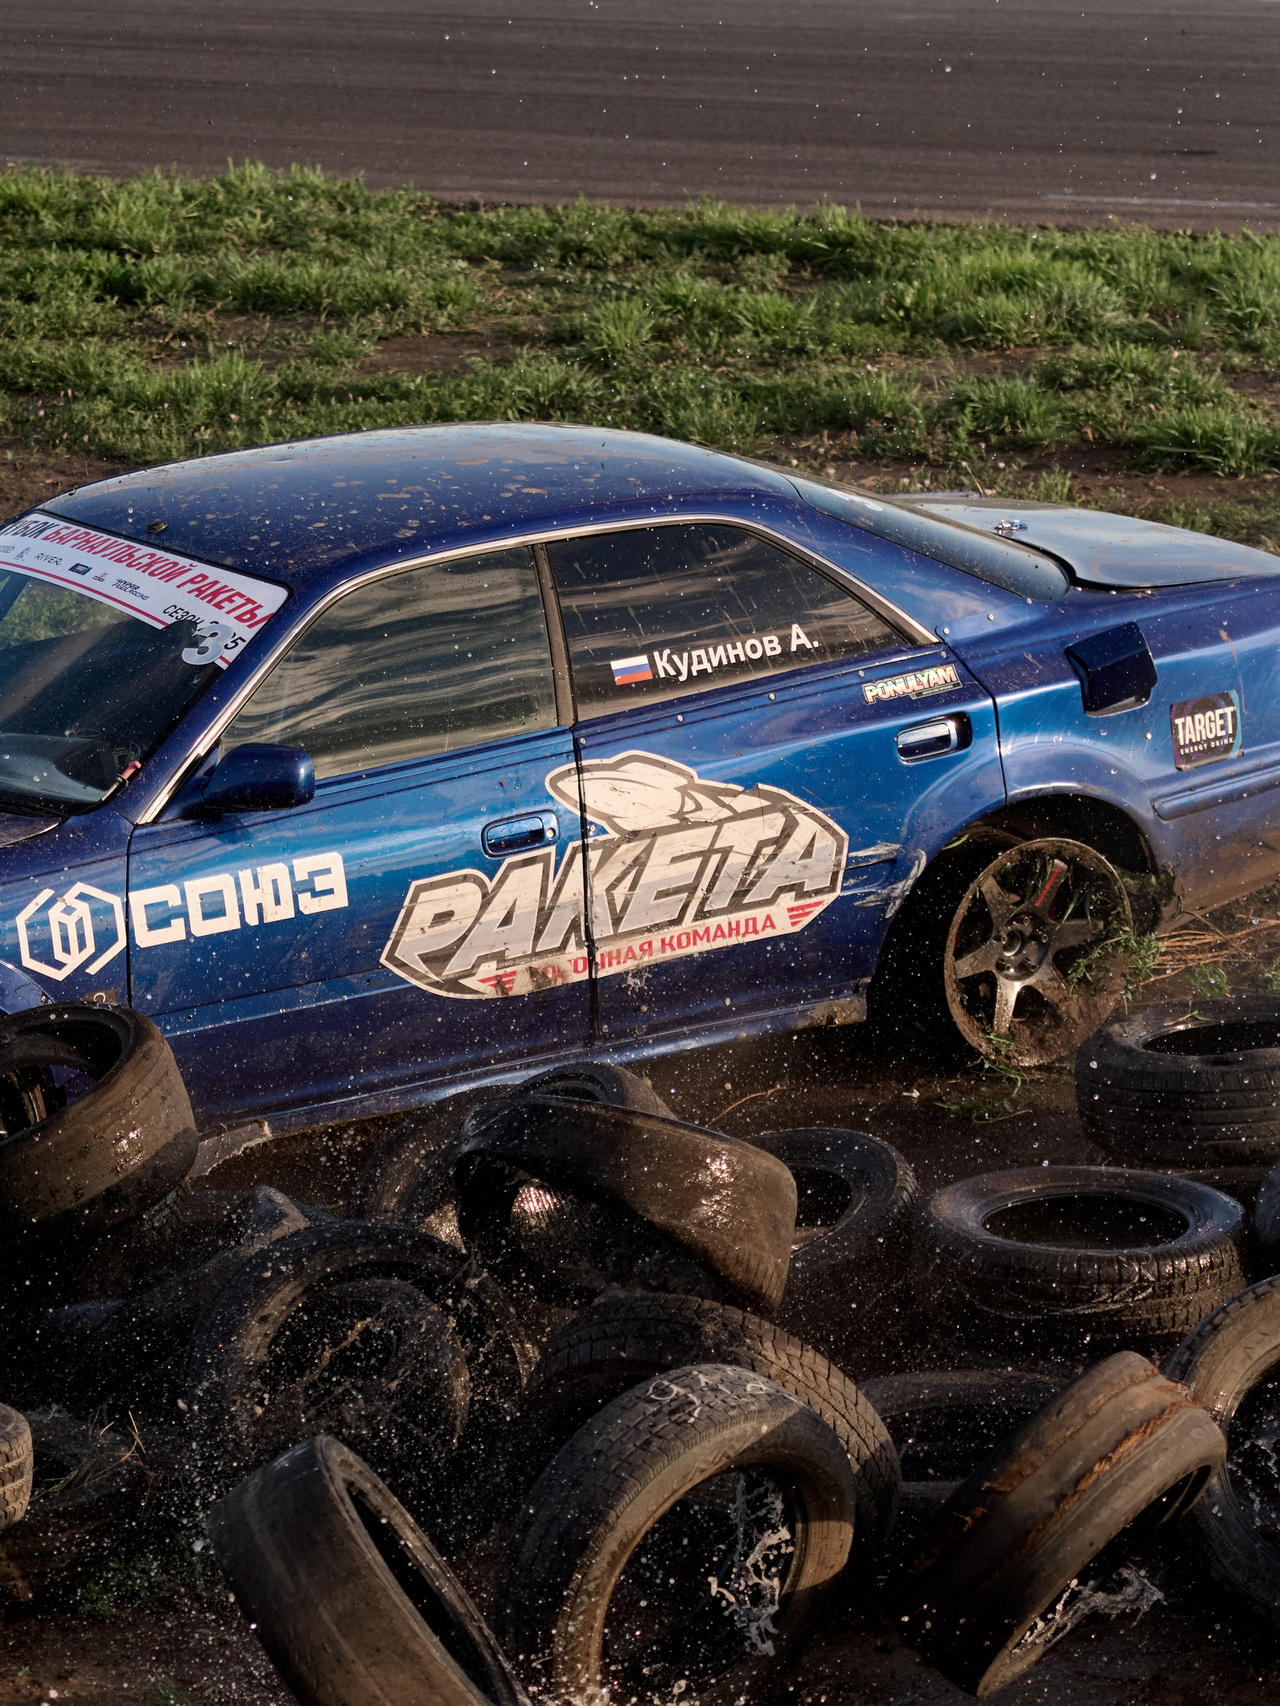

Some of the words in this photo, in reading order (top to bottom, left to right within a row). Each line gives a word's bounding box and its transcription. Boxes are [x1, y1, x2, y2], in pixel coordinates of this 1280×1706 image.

[34, 552, 63, 566] RIVER
[41, 526, 197, 583] БАРНАУЛЬСКОЙ
[176, 573, 274, 629] РАКЕТЫ
[181, 623, 234, 665] 3
[653, 634, 782, 682] Кудинов
[790, 623, 820, 652] А.
[864, 665, 958, 703] PONULYAM
[1173, 706, 1236, 746] TARGET
[1180, 743, 1208, 755] ENERGY
[129, 851, 349, 949] СОЮЗ
[393, 808, 839, 981] РАКЕТА
[660, 914, 777, 957] КОМАНДА
